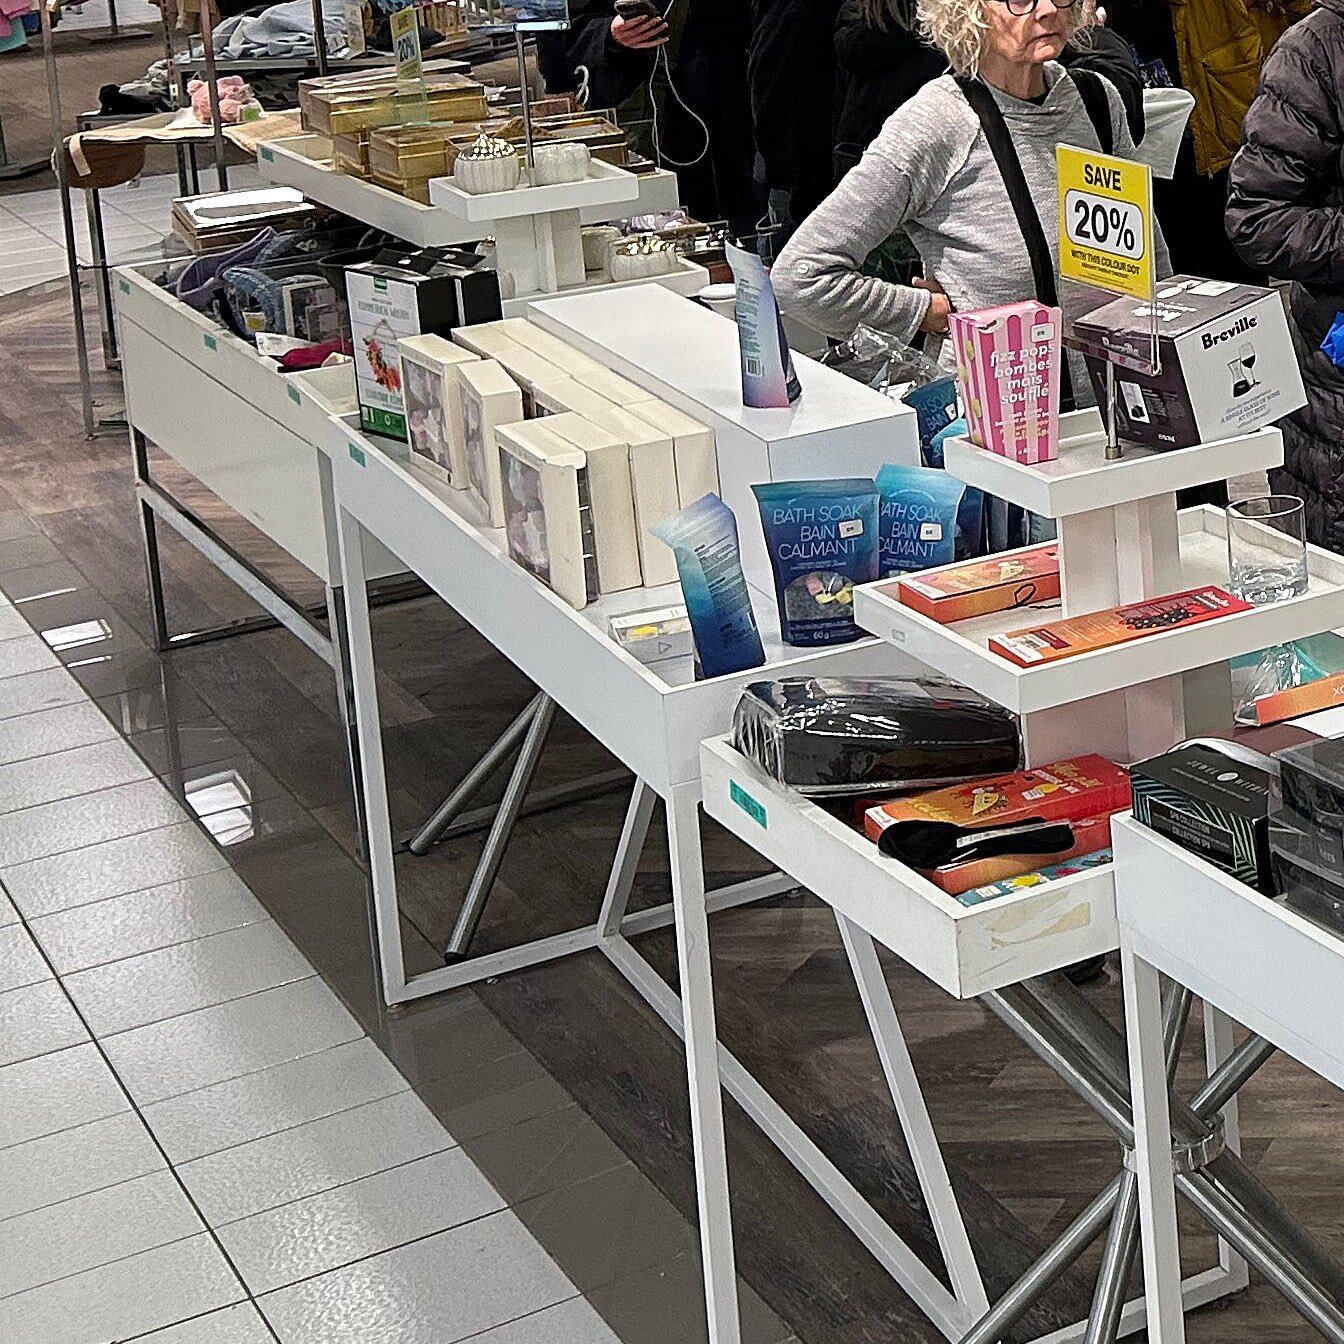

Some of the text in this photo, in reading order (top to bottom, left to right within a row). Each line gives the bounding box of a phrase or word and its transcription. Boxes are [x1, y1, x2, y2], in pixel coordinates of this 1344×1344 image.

[1084, 163, 1122, 192] SAVE
[1074, 199, 1135, 251] 20%
[1087, 254, 1100, 264] THIS
[1100, 256, 1127, 270] COLOUR
[1126, 264, 1141, 275] DOT
[1201, 314, 1259, 351] Breville
[990, 343, 1054, 368] fizz pops
[994, 358, 1052, 380] bombes
[1000, 381, 1050, 406] soufflé
[773, 504, 862, 525] BATH SOAK
[908, 504, 943, 522] SOAK
[799, 525, 836, 542] BAIN
[891, 522, 920, 540] BAIN
[778, 538, 858, 560] CALMANT
[879, 535, 937, 558] CALMANT
